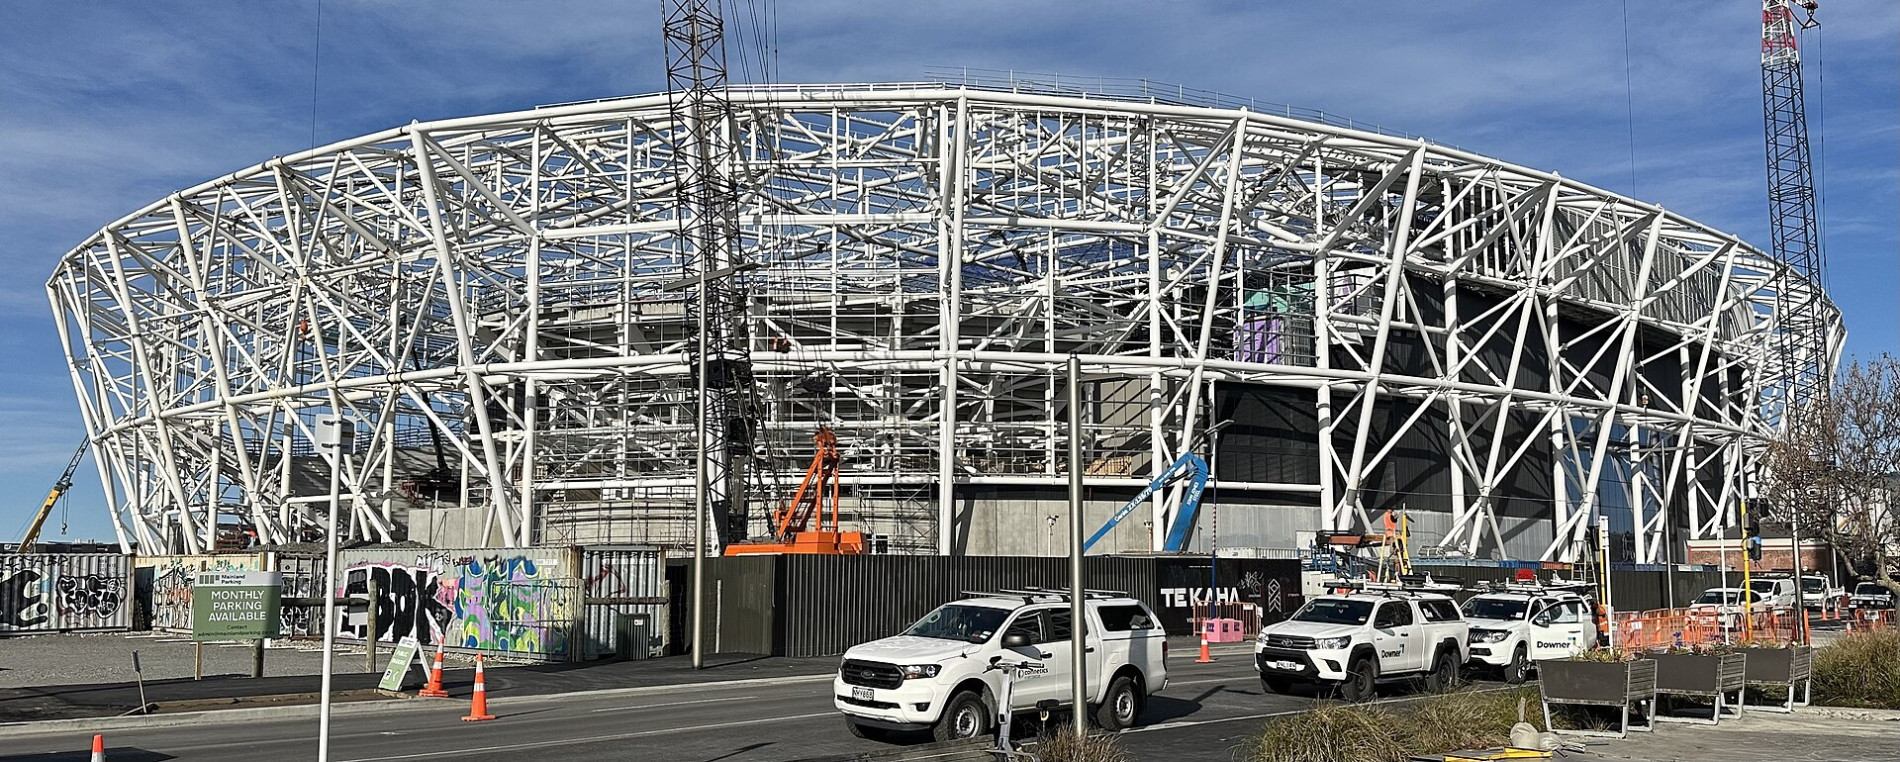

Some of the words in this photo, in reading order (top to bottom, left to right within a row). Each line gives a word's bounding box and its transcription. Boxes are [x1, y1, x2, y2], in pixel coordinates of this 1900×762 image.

[211, 590, 264, 600] MONTHLY
[1160, 587, 1187, 608] TE
[1189, 586, 1240, 607] KAHA
[213, 601, 262, 611] PARKING
[208, 611, 267, 622] AVAILABLE
[1537, 641, 1571, 649] Downer
[1381, 649, 1401, 658] Downer
